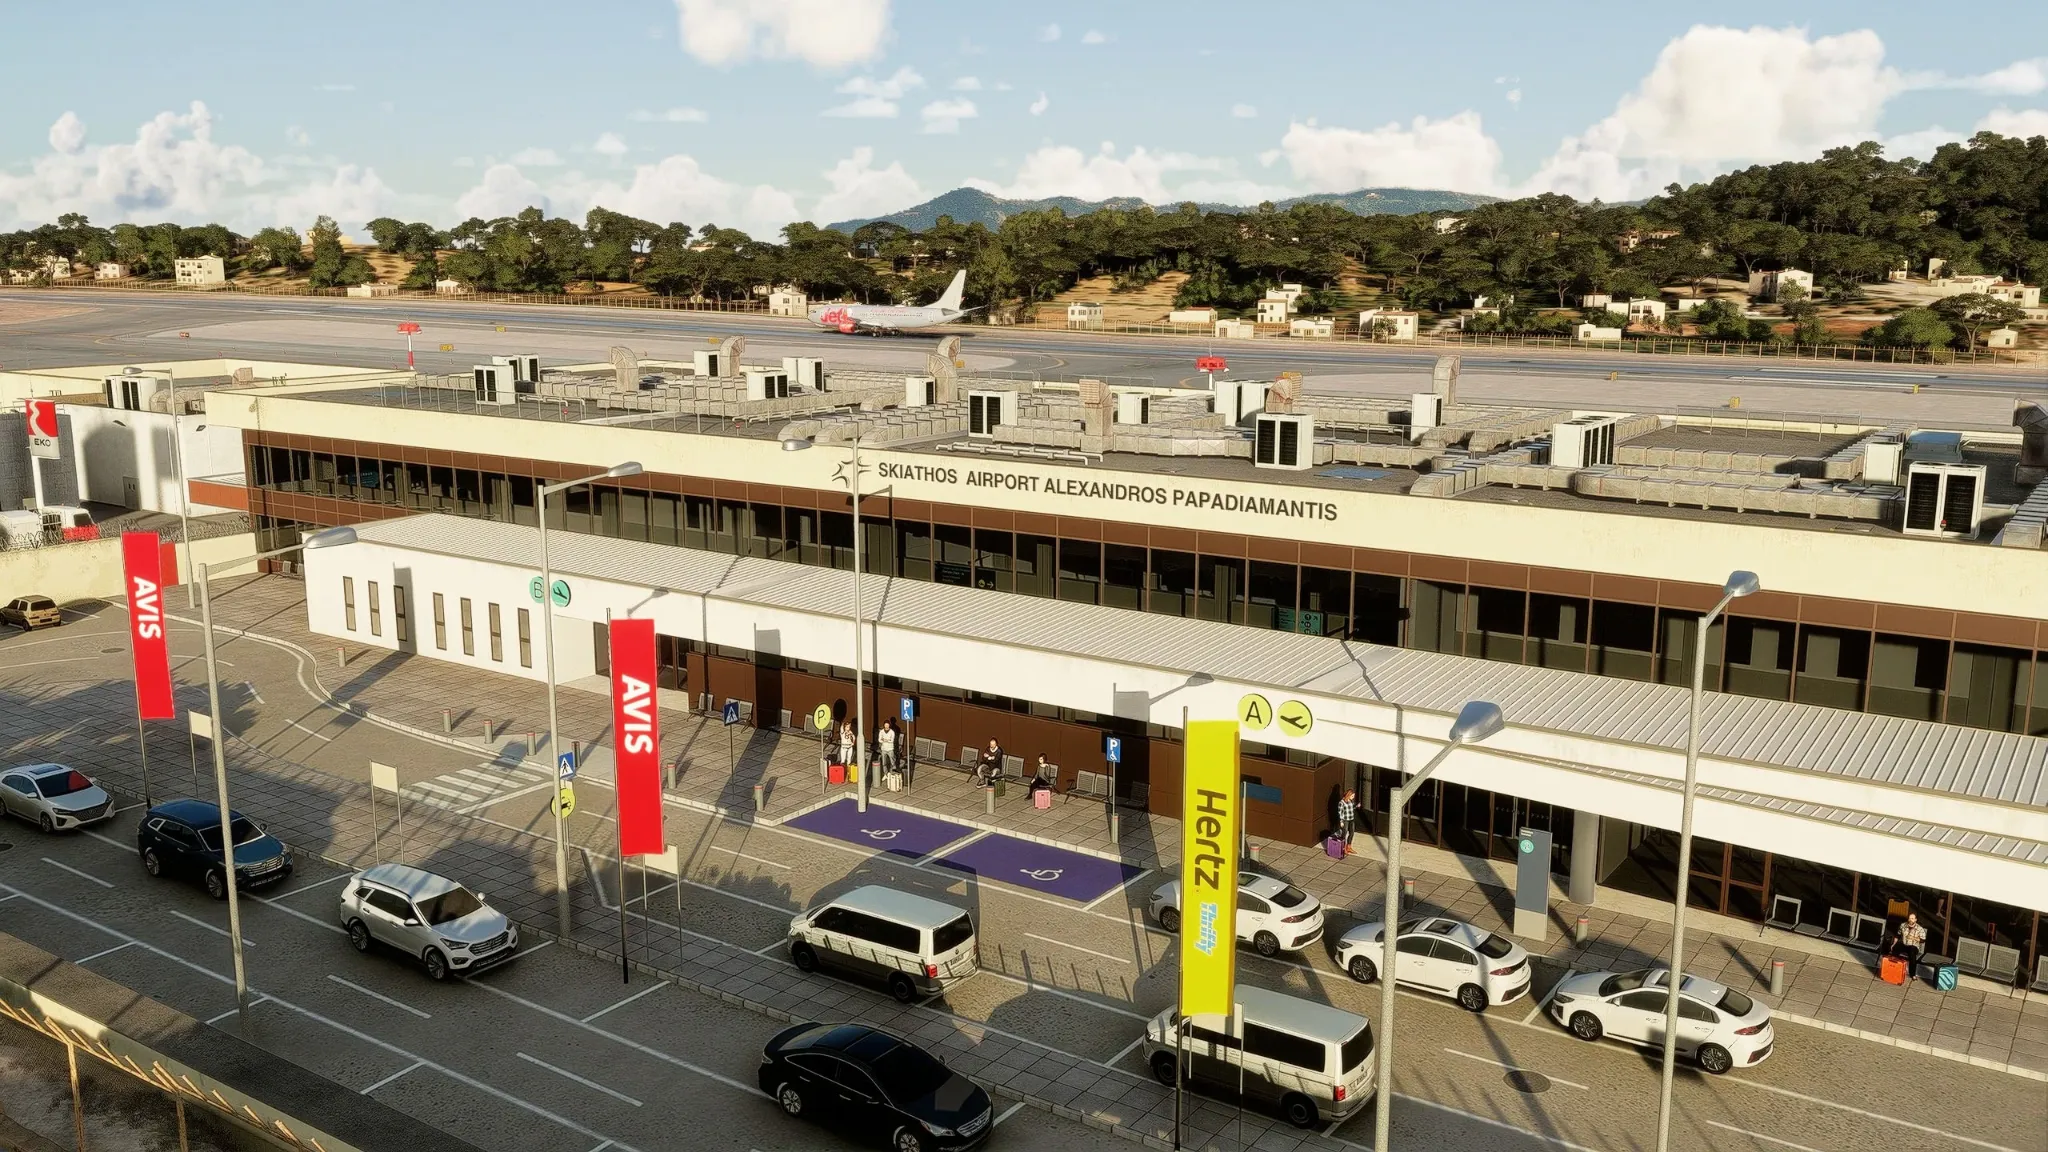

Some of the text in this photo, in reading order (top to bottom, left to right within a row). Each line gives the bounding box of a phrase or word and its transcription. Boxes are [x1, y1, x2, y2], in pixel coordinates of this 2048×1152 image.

[34, 438, 51, 447] EKO
[878, 462, 1338, 521] SKIATHOS AIRPORT ALEXANDROS PAPADIAMANTIS
[534, 581, 544, 599] B
[133, 576, 162, 639] AVIS
[621, 673, 653, 755] AVIS
[903, 699, 911, 711] P
[1245, 700, 1262, 724] A
[817, 709, 825, 724] P
[1110, 739, 1118, 751] P
[1194, 788, 1227, 890] Hertz
